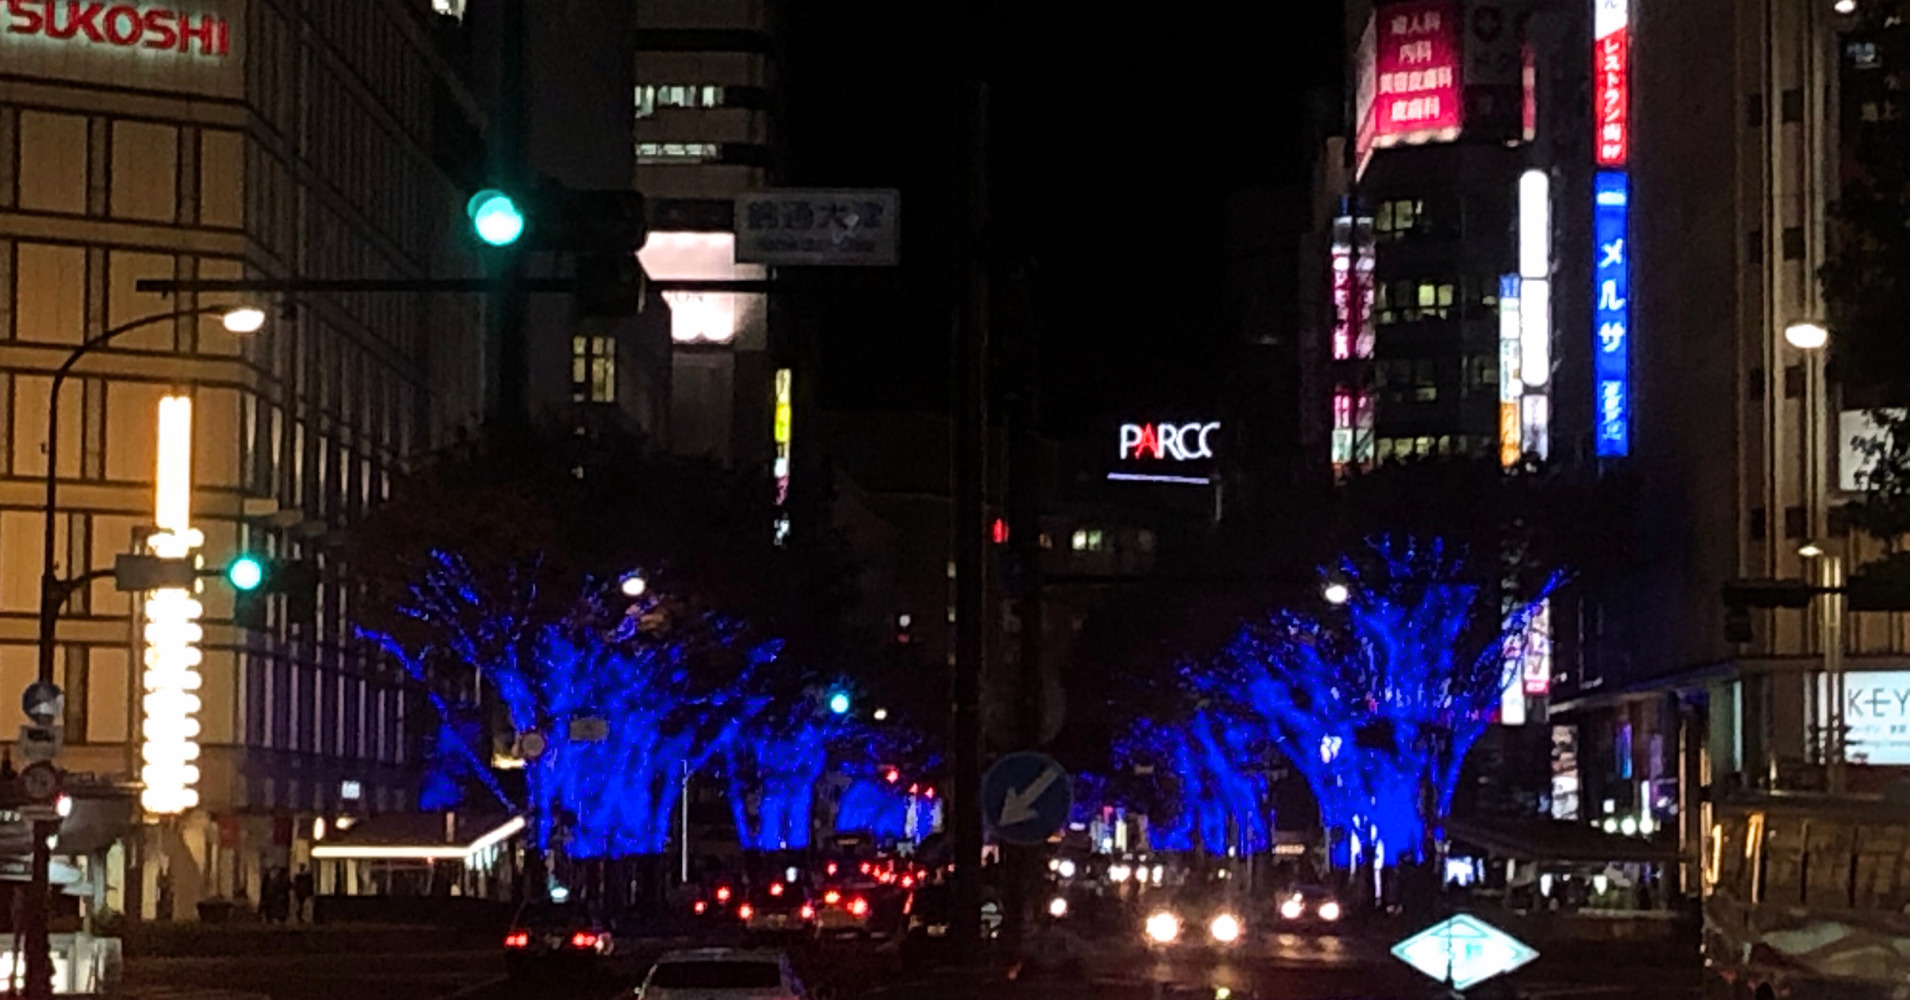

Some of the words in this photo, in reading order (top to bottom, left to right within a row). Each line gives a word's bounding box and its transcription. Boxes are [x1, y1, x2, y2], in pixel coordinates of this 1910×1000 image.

[0, 0, 229, 56] SUKOSHI
[1597, 238, 1627, 353] メルサ
